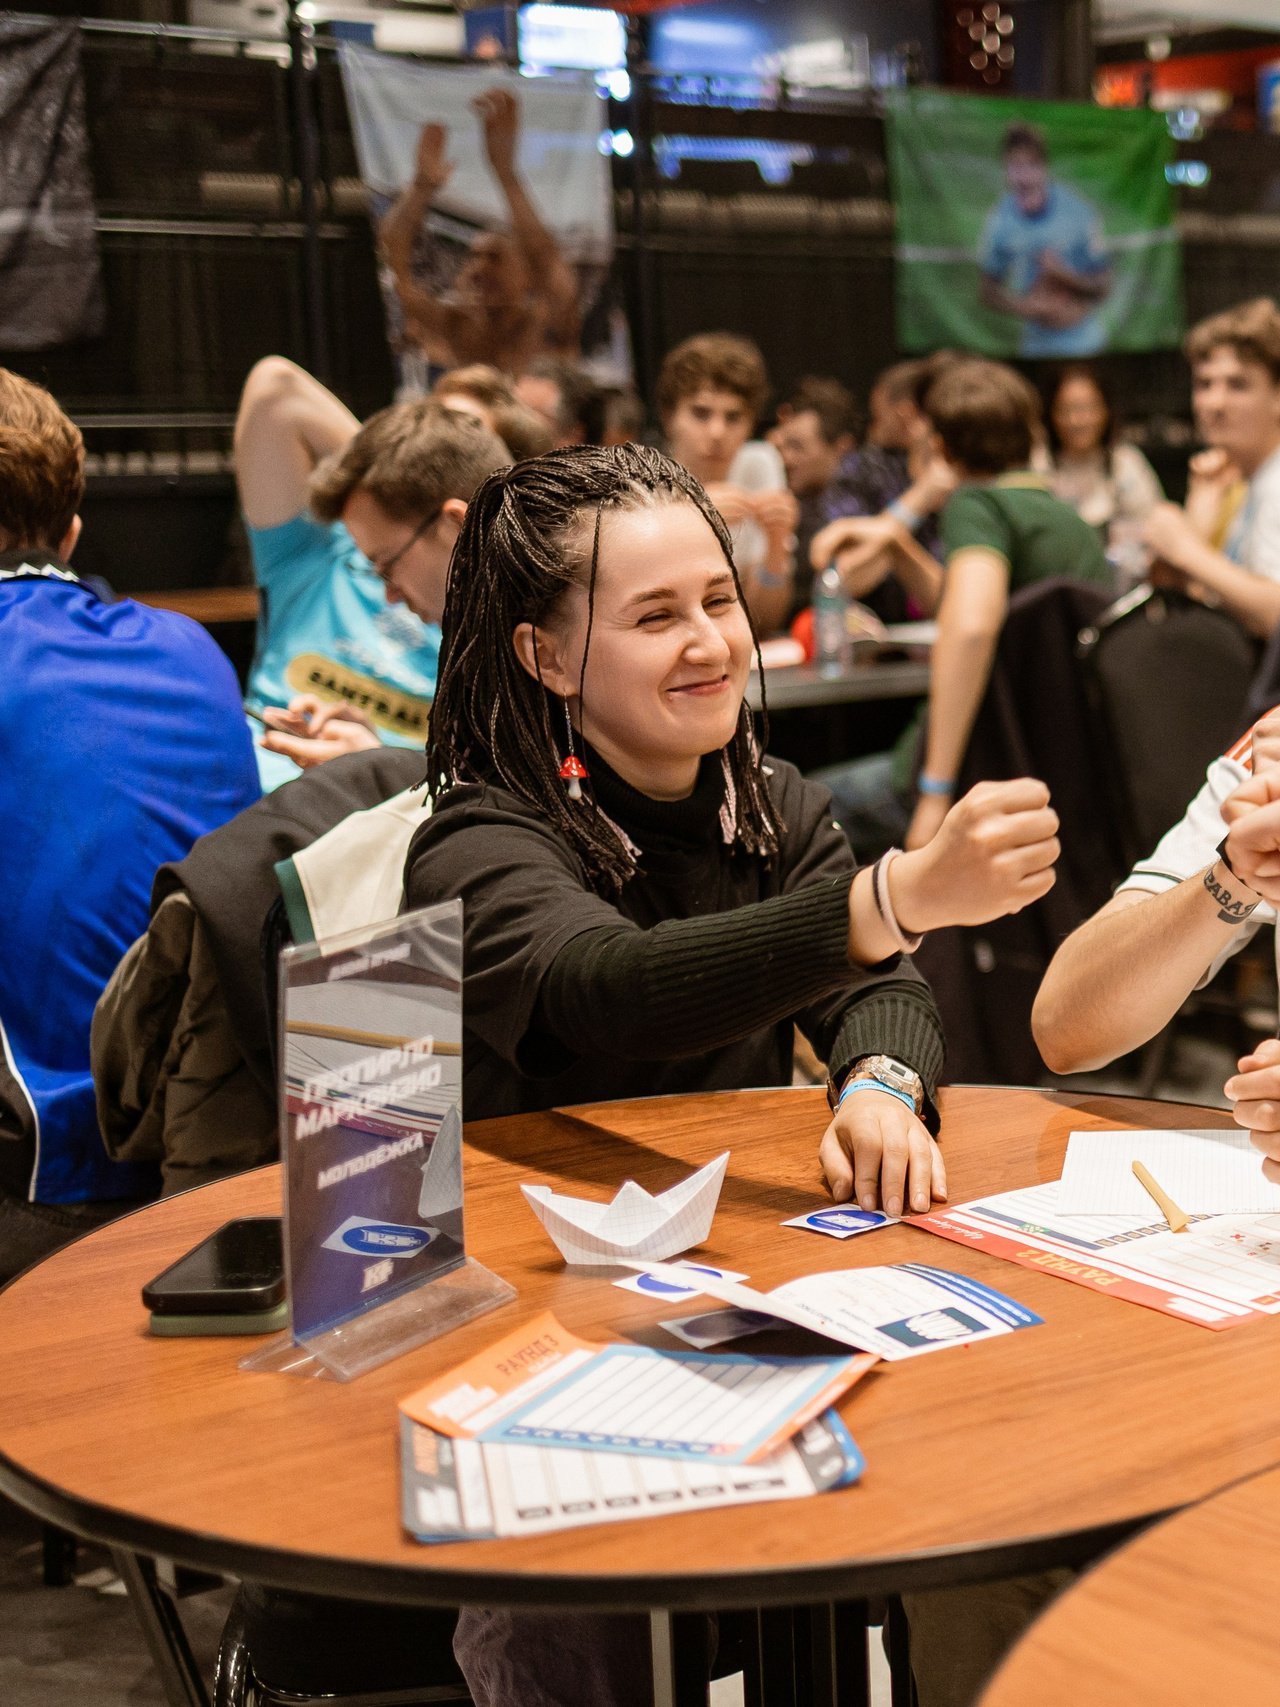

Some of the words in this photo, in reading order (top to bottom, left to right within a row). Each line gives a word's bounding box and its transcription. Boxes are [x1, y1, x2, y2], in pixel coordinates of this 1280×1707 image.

[1016, 1249, 1040, 1258] 2
[1029, 1253, 1122, 1286] РАУНД
[496, 1340, 552, 1376] РАУНД
[543, 1334, 559, 1346] 3
